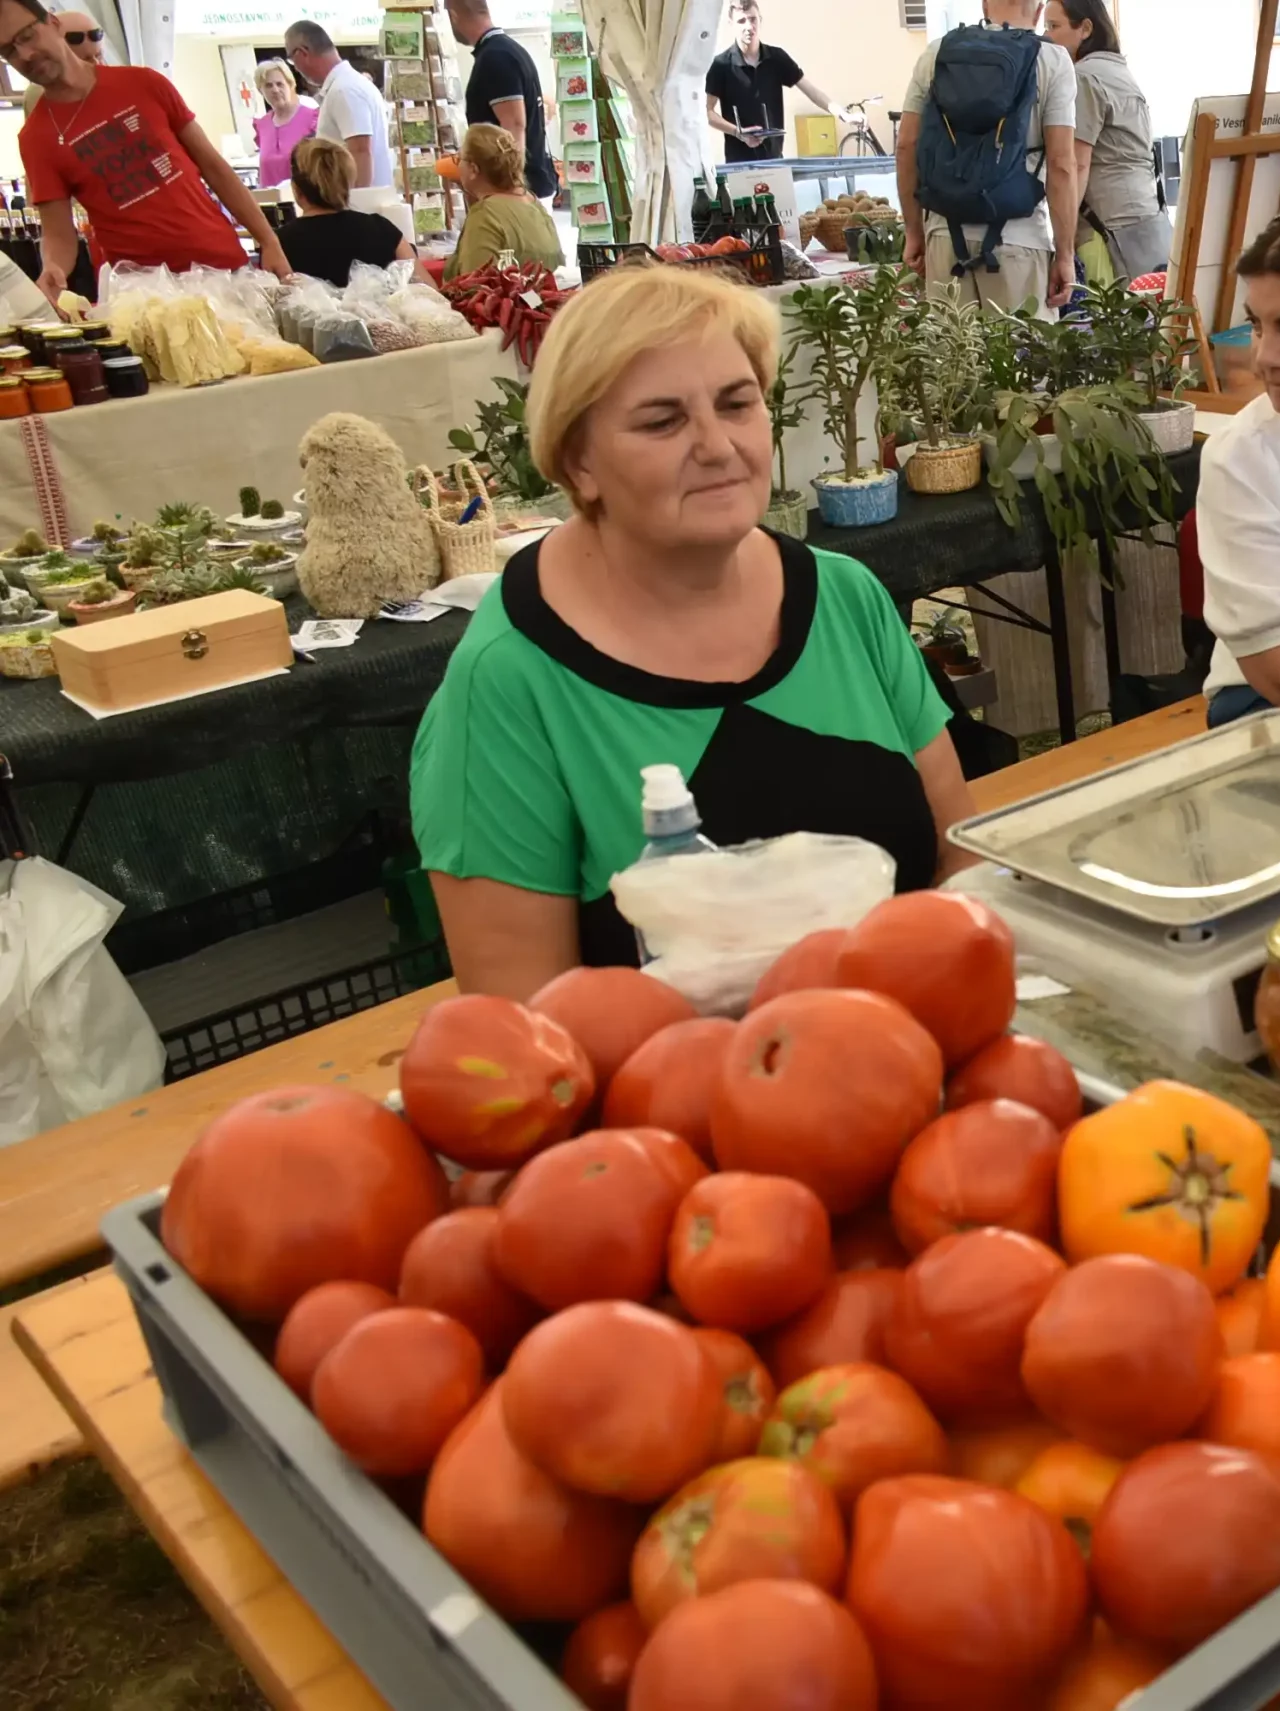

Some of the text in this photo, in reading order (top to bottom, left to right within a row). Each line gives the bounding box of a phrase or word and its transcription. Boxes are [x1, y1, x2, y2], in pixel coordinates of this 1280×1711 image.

[351, 15, 380, 26] JEDNO
[1222, 117, 1246, 129] Vesn
[92, 137, 162, 178] YORK
